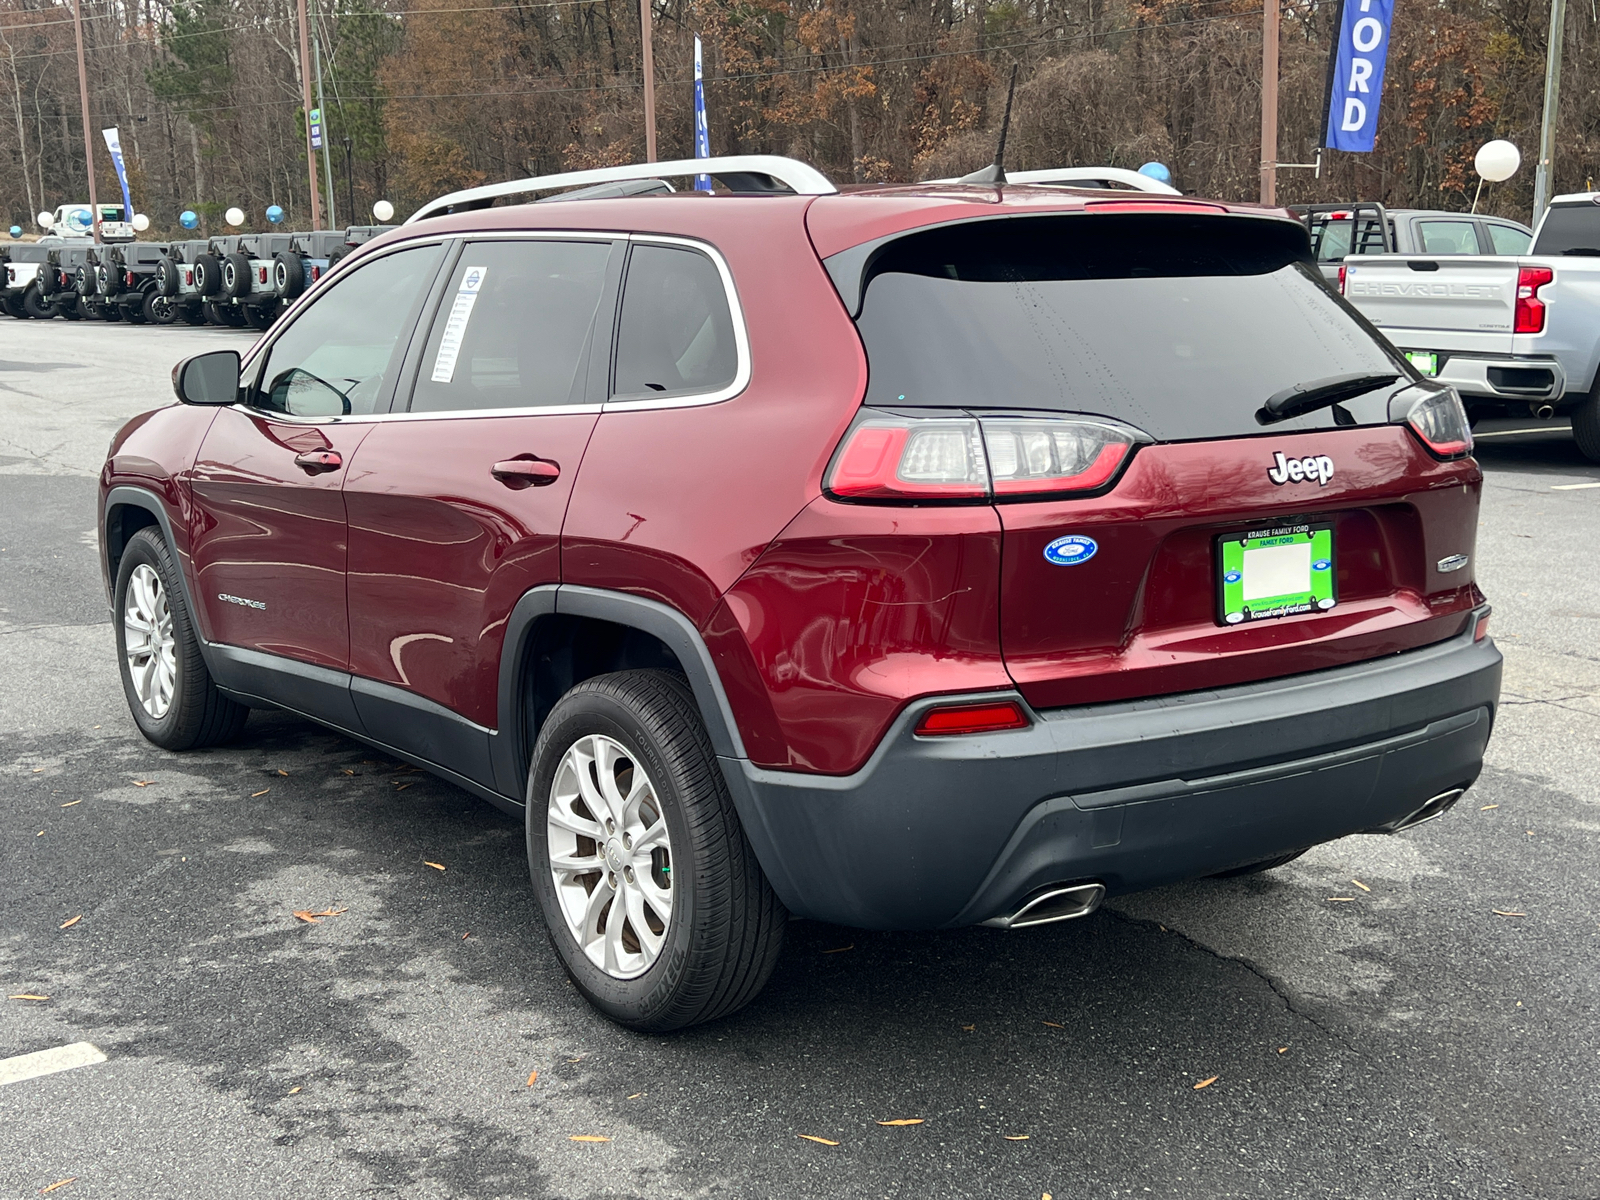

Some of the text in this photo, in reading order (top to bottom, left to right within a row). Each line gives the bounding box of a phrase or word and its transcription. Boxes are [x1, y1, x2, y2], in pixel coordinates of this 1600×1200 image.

[1352, 282, 1500, 298] CHEVROLET
[1267, 451, 1335, 487] Jeep
[1247, 524, 1309, 539] KRAUSE FAMILY FORD
[1051, 537, 1091, 549] KRAUSE FAMILY
[1259, 536, 1294, 547] FAMILY FORD
[1062, 545, 1080, 555] Ford
[217, 593, 267, 611] CHEROKEE
[635, 729, 664, 779] TOURING
